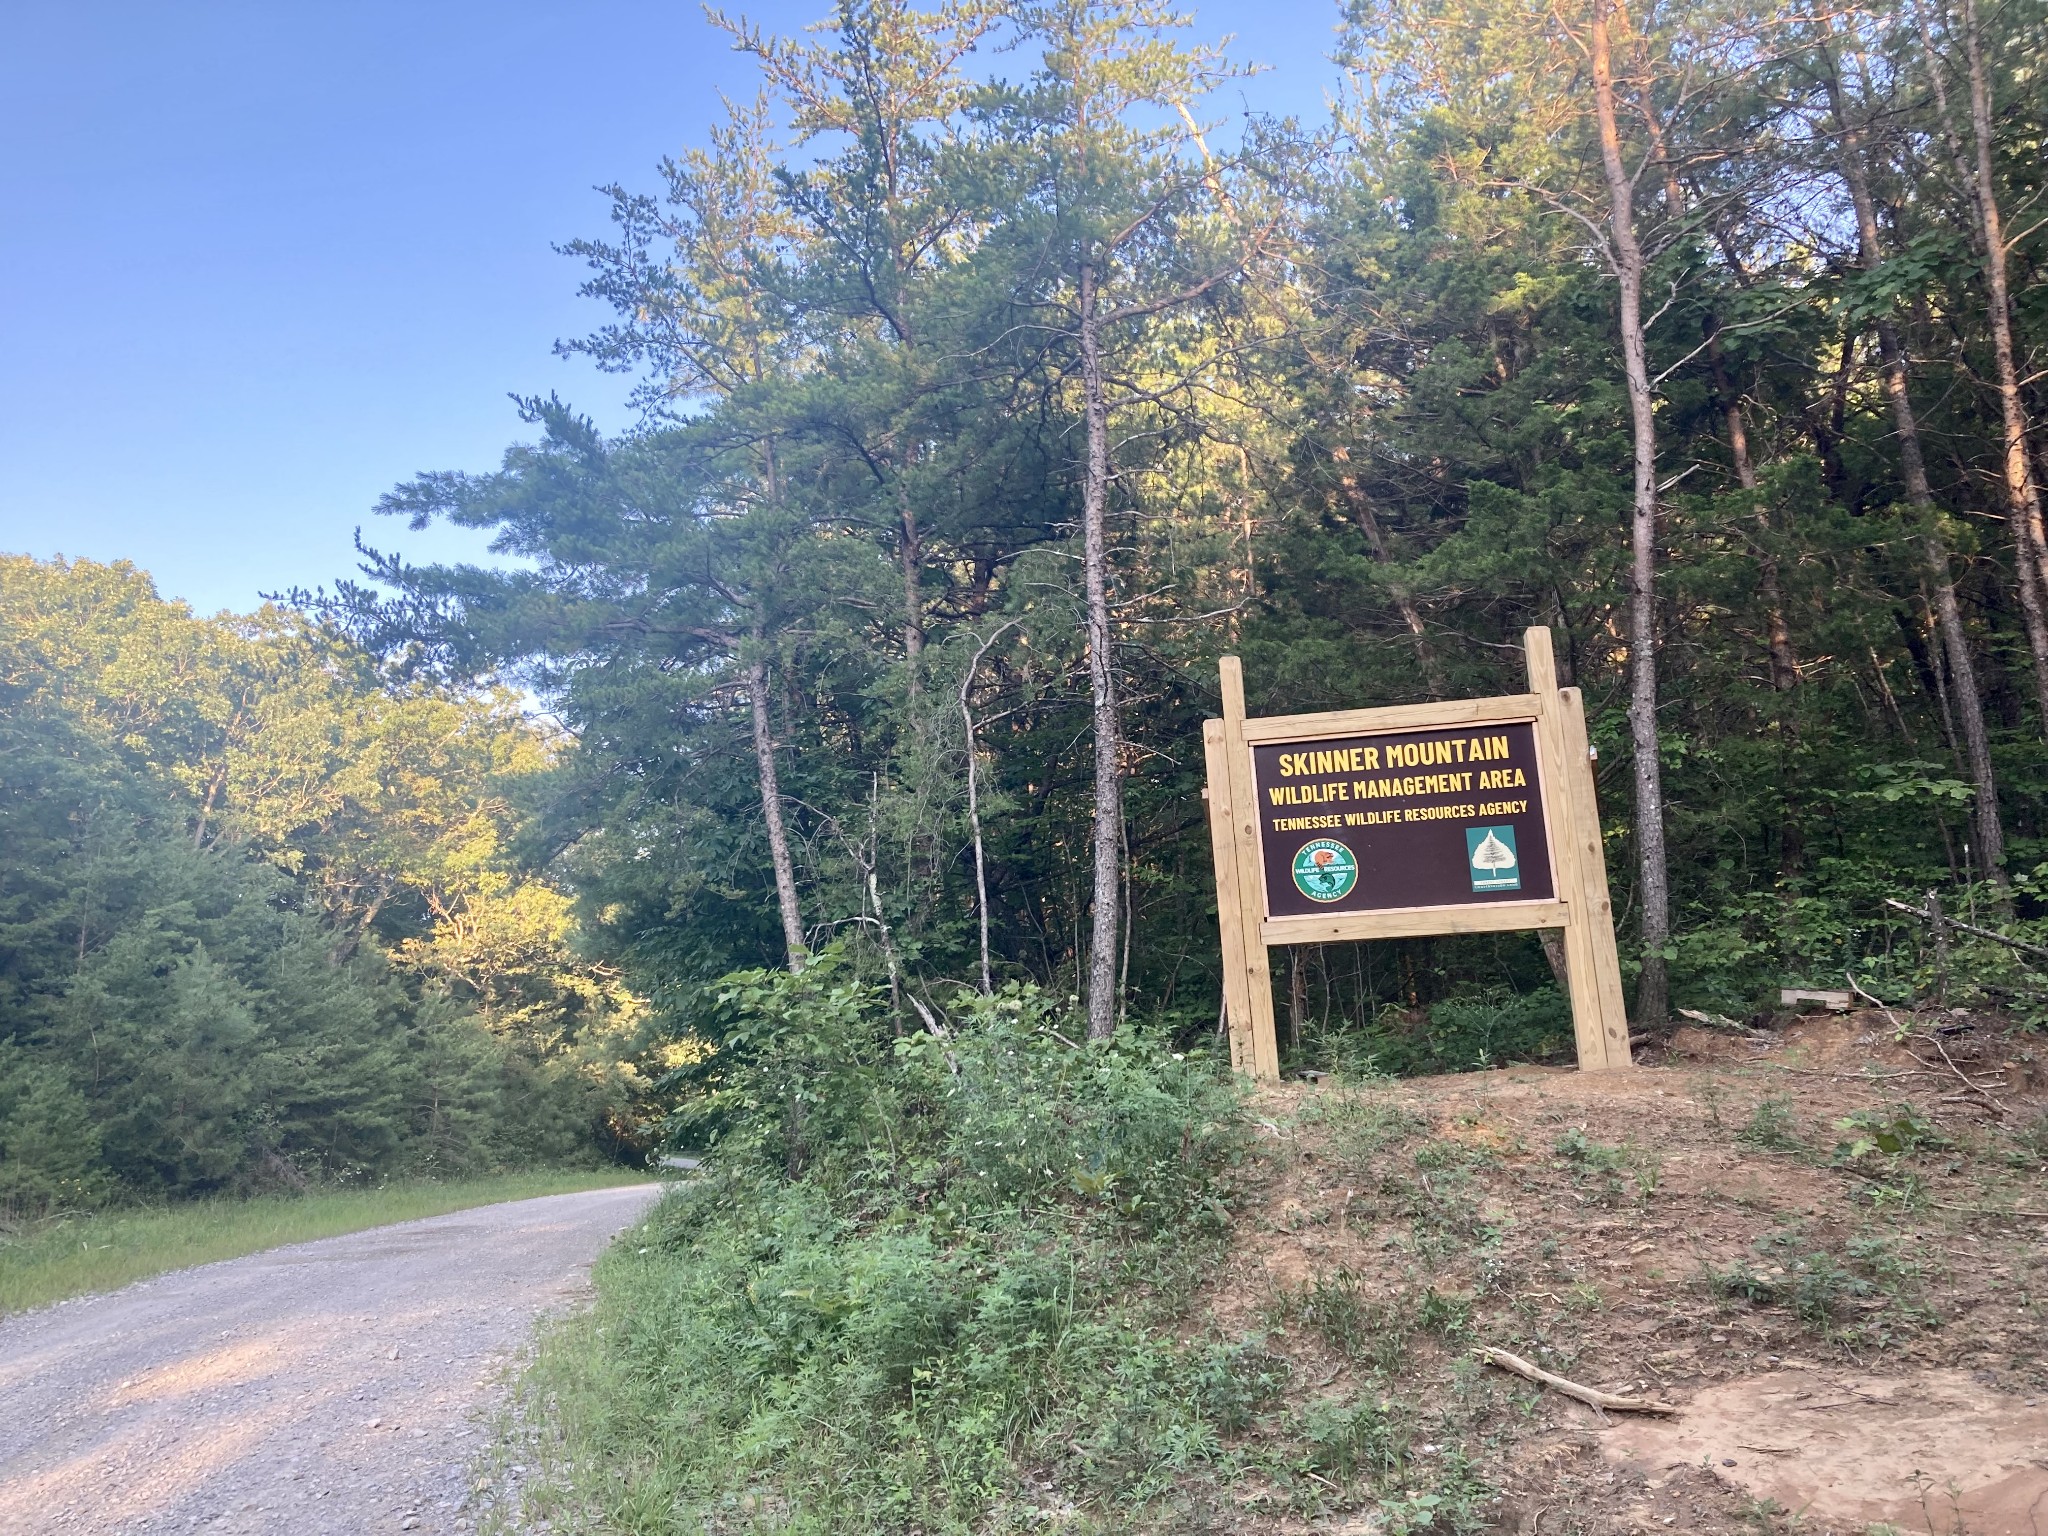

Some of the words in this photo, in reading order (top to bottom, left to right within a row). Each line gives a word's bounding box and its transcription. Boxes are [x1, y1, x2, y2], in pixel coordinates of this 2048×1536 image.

[1279, 747, 1380, 777] SKINNER
[1386, 736, 1509, 769] MOUNTAIN
[1269, 782, 1349, 806] WILDLIFE
[1354, 772, 1473, 800] MANAGEMENT
[1480, 768, 1526, 790] AREA
[1273, 814, 1342, 832] TENNESSEE
[1345, 810, 1401, 826] WILDLIFE
[1405, 805, 1476, 822] RESOURCES
[1478, 800, 1528, 816] AGENCY
[1302, 842, 1344, 855] TENNESSEE
[1311, 889, 1342, 898] AGENCY
